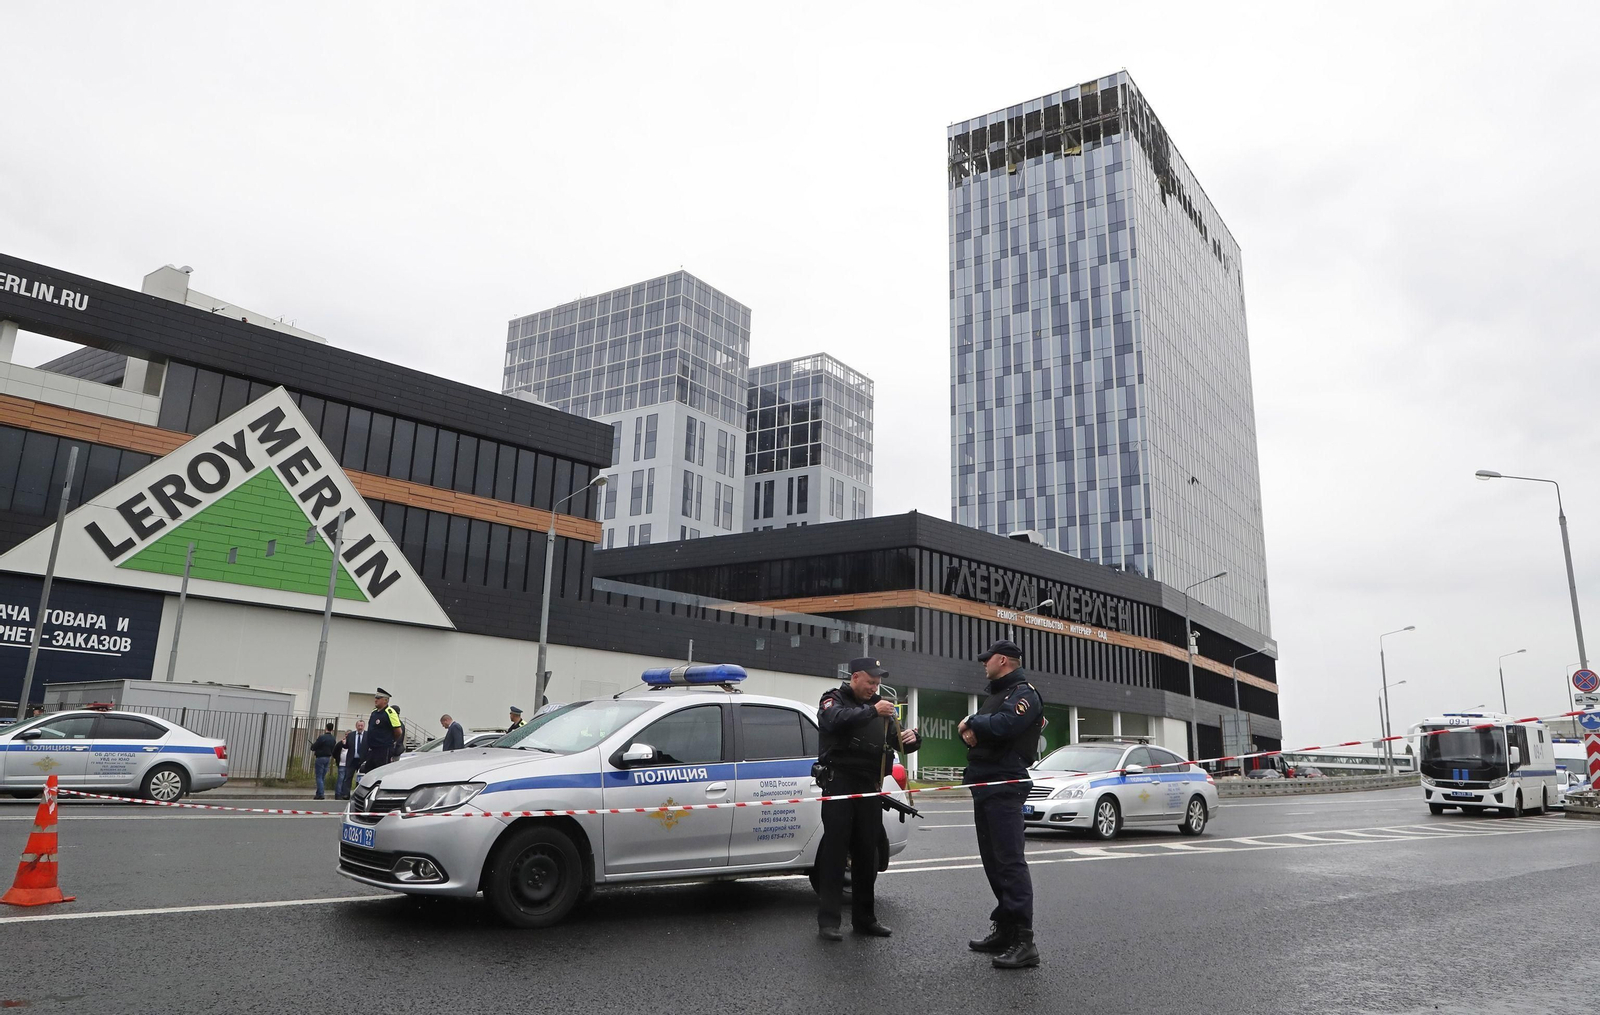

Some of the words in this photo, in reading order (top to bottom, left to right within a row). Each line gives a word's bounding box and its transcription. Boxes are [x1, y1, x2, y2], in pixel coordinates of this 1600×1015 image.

[84, 430, 255, 562] LEROY
[247, 406, 402, 599] MERLIN
[955, 565, 1033, 610] ЛЕРУА
[1051, 586, 1131, 633] МЕРЛЕН
[43, 609, 107, 630] ТОВАРА
[117, 617, 130, 632] И
[997, 609, 1018, 621] РЕМОНТ
[1024, 615, 1064, 631] СТРОИТЕЛЬСТВО
[1070, 624, 1092, 636] ИНТЕРЬЕР
[1097, 630, 1108, 641] САД
[1449, 718, 1470, 726] 09-1
[25, 744, 71, 752] ПОЛИЦИЯ
[633, 768, 708, 784] ПОЛИЦИЯ
[760, 780, 777, 789] ОМВД
[778, 780, 798, 788] России
